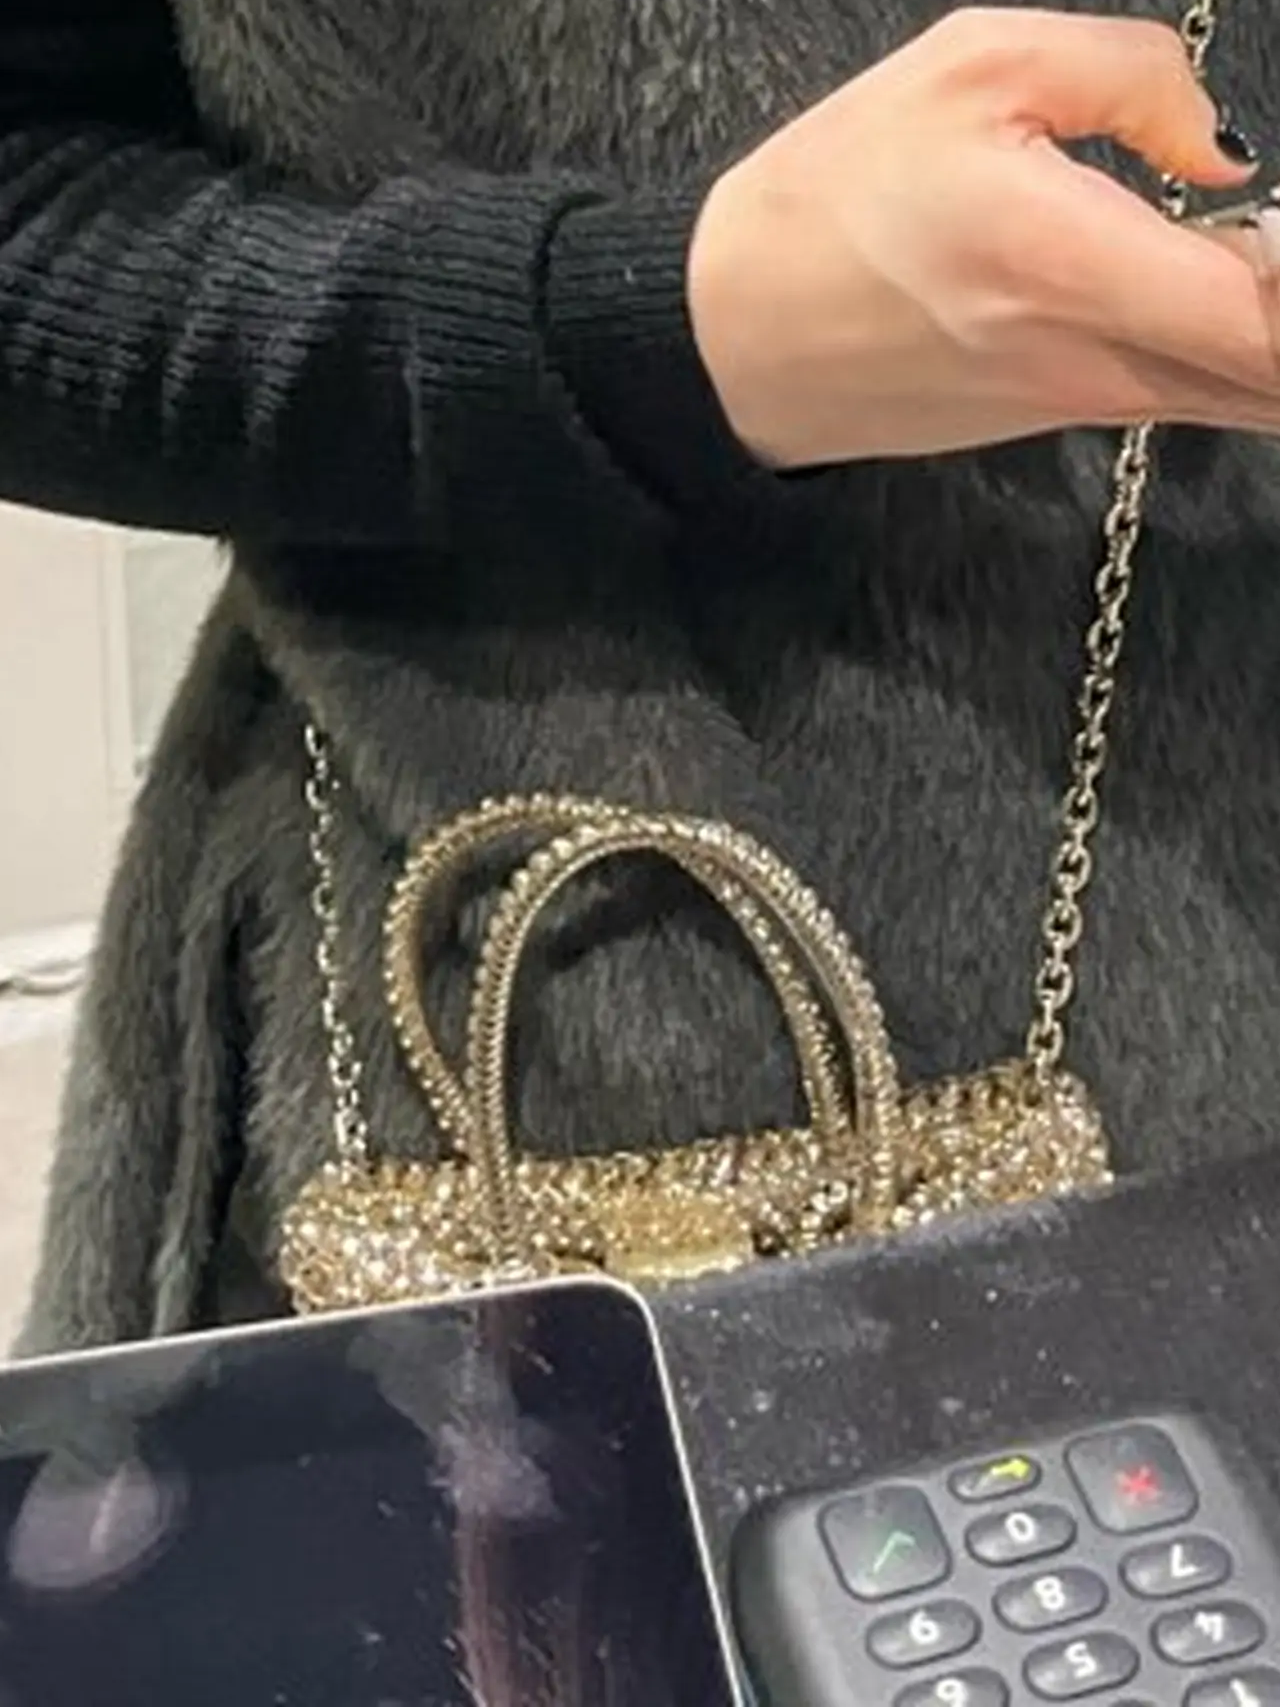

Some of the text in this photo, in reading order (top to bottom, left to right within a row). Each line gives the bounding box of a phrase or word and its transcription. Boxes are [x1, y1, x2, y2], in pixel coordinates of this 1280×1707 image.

[1005, 1512, 1036, 1544] 0
[1170, 1543, 1197, 1578] 7
[1033, 1575, 1066, 1610] 8
[1194, 1610, 1227, 1643] 4
[1065, 1641, 1098, 1680] 5
